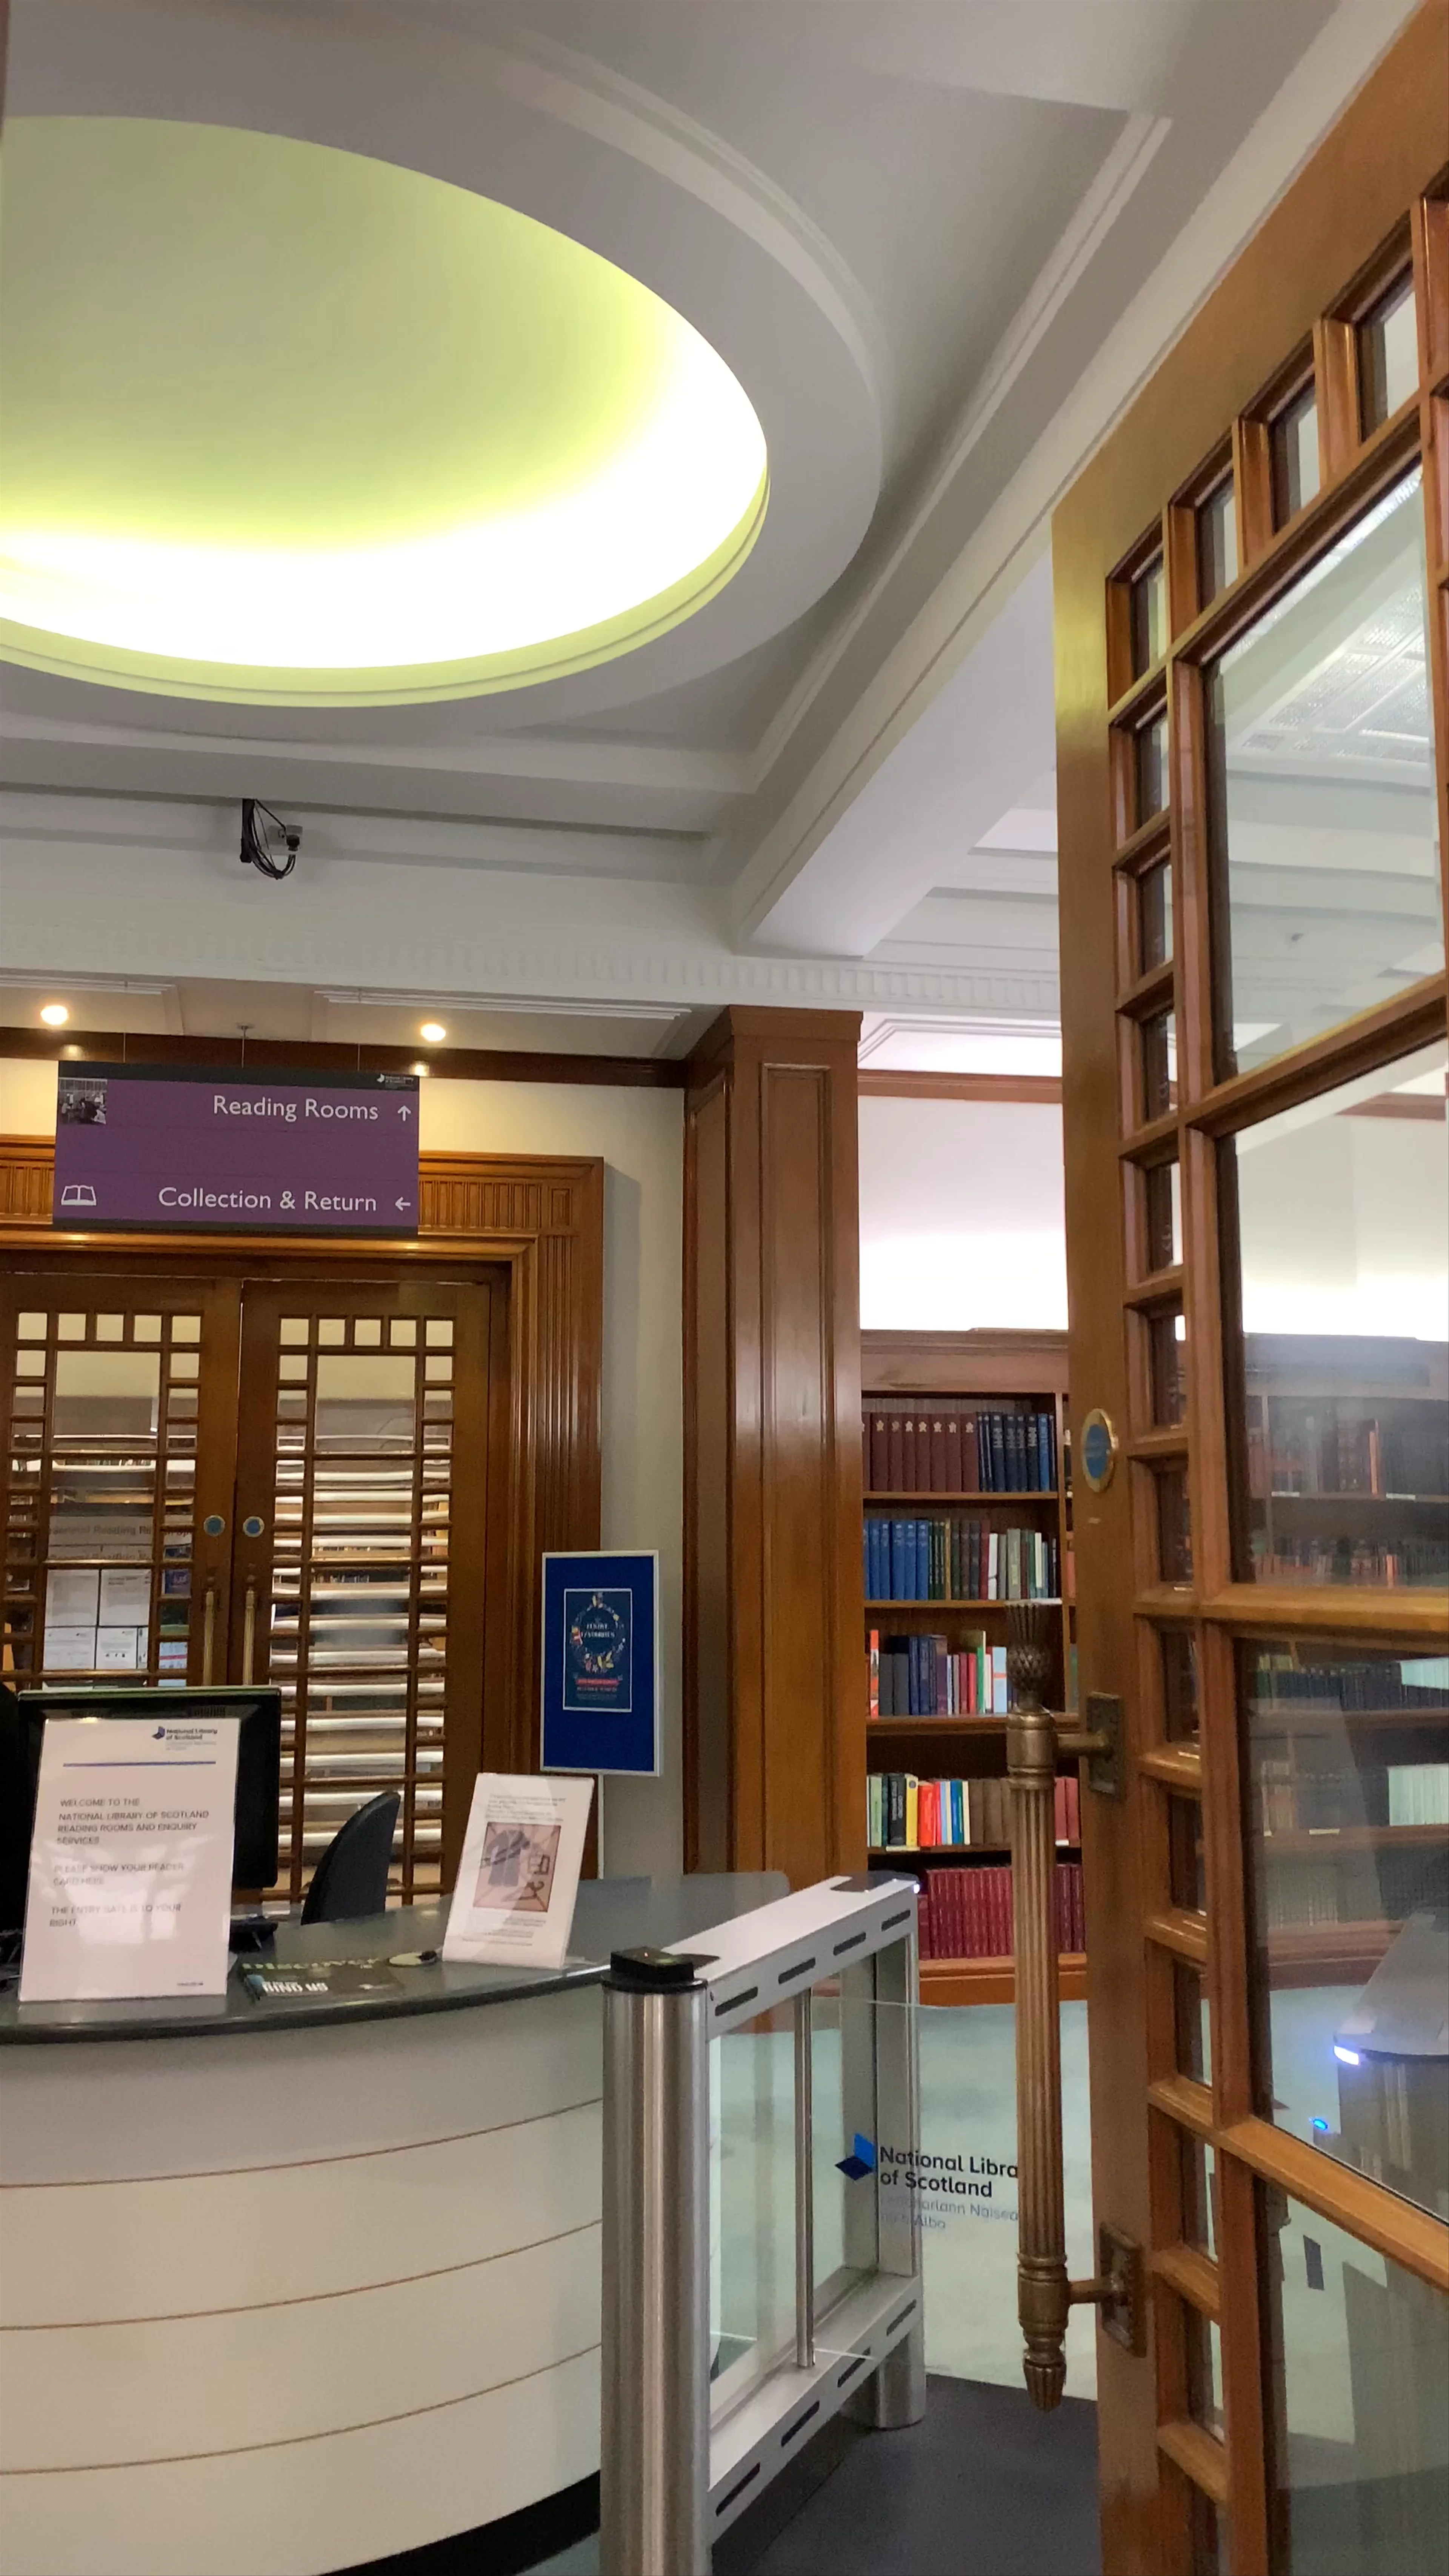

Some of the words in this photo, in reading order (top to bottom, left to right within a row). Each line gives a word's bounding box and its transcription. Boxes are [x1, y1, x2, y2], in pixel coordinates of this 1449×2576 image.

[214, 1095, 297, 1122] Reading
[305, 1098, 378, 1120] Rooms
[158, 1186, 271, 1209] Collection
[280, 1190, 296, 1209] &
[305, 1191, 377, 1212] Return
[60, 1798, 105, 1807] WELCOME
[123, 1797, 140, 1806] THE
[57, 1825, 98, 1833] READING
[100, 1824, 134, 1832] ROOMS
[158, 1822, 197, 1831] ENQUIRY
[880, 2146, 964, 2172] National
[970, 2156, 1018, 2179] Libra
[880, 2169, 899, 2185] of
[905, 2170, 992, 2198] Scotland
